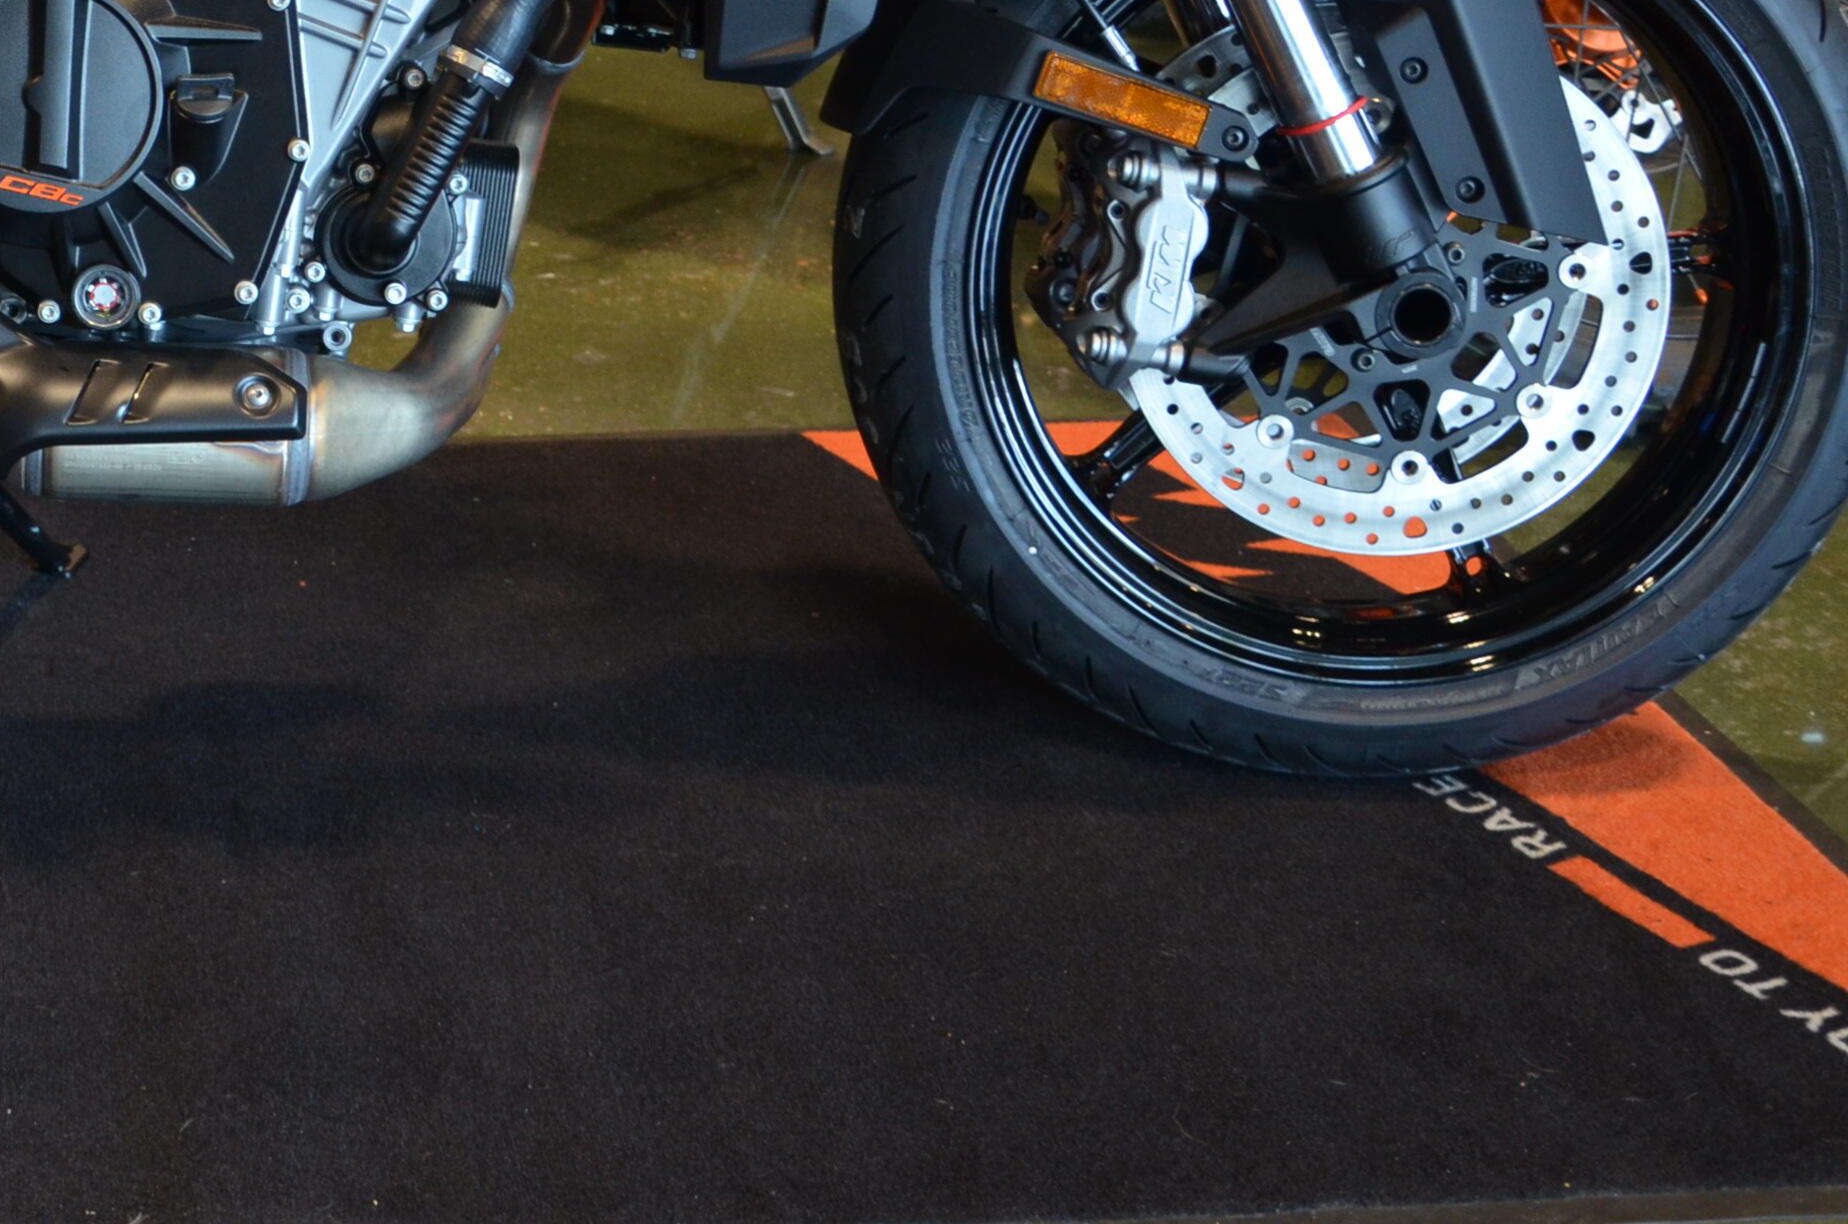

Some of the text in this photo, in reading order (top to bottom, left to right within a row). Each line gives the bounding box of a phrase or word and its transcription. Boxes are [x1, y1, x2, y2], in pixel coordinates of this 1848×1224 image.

[1146, 225, 1186, 315] KTM
[1413, 774, 1790, 1001] TO RACE
